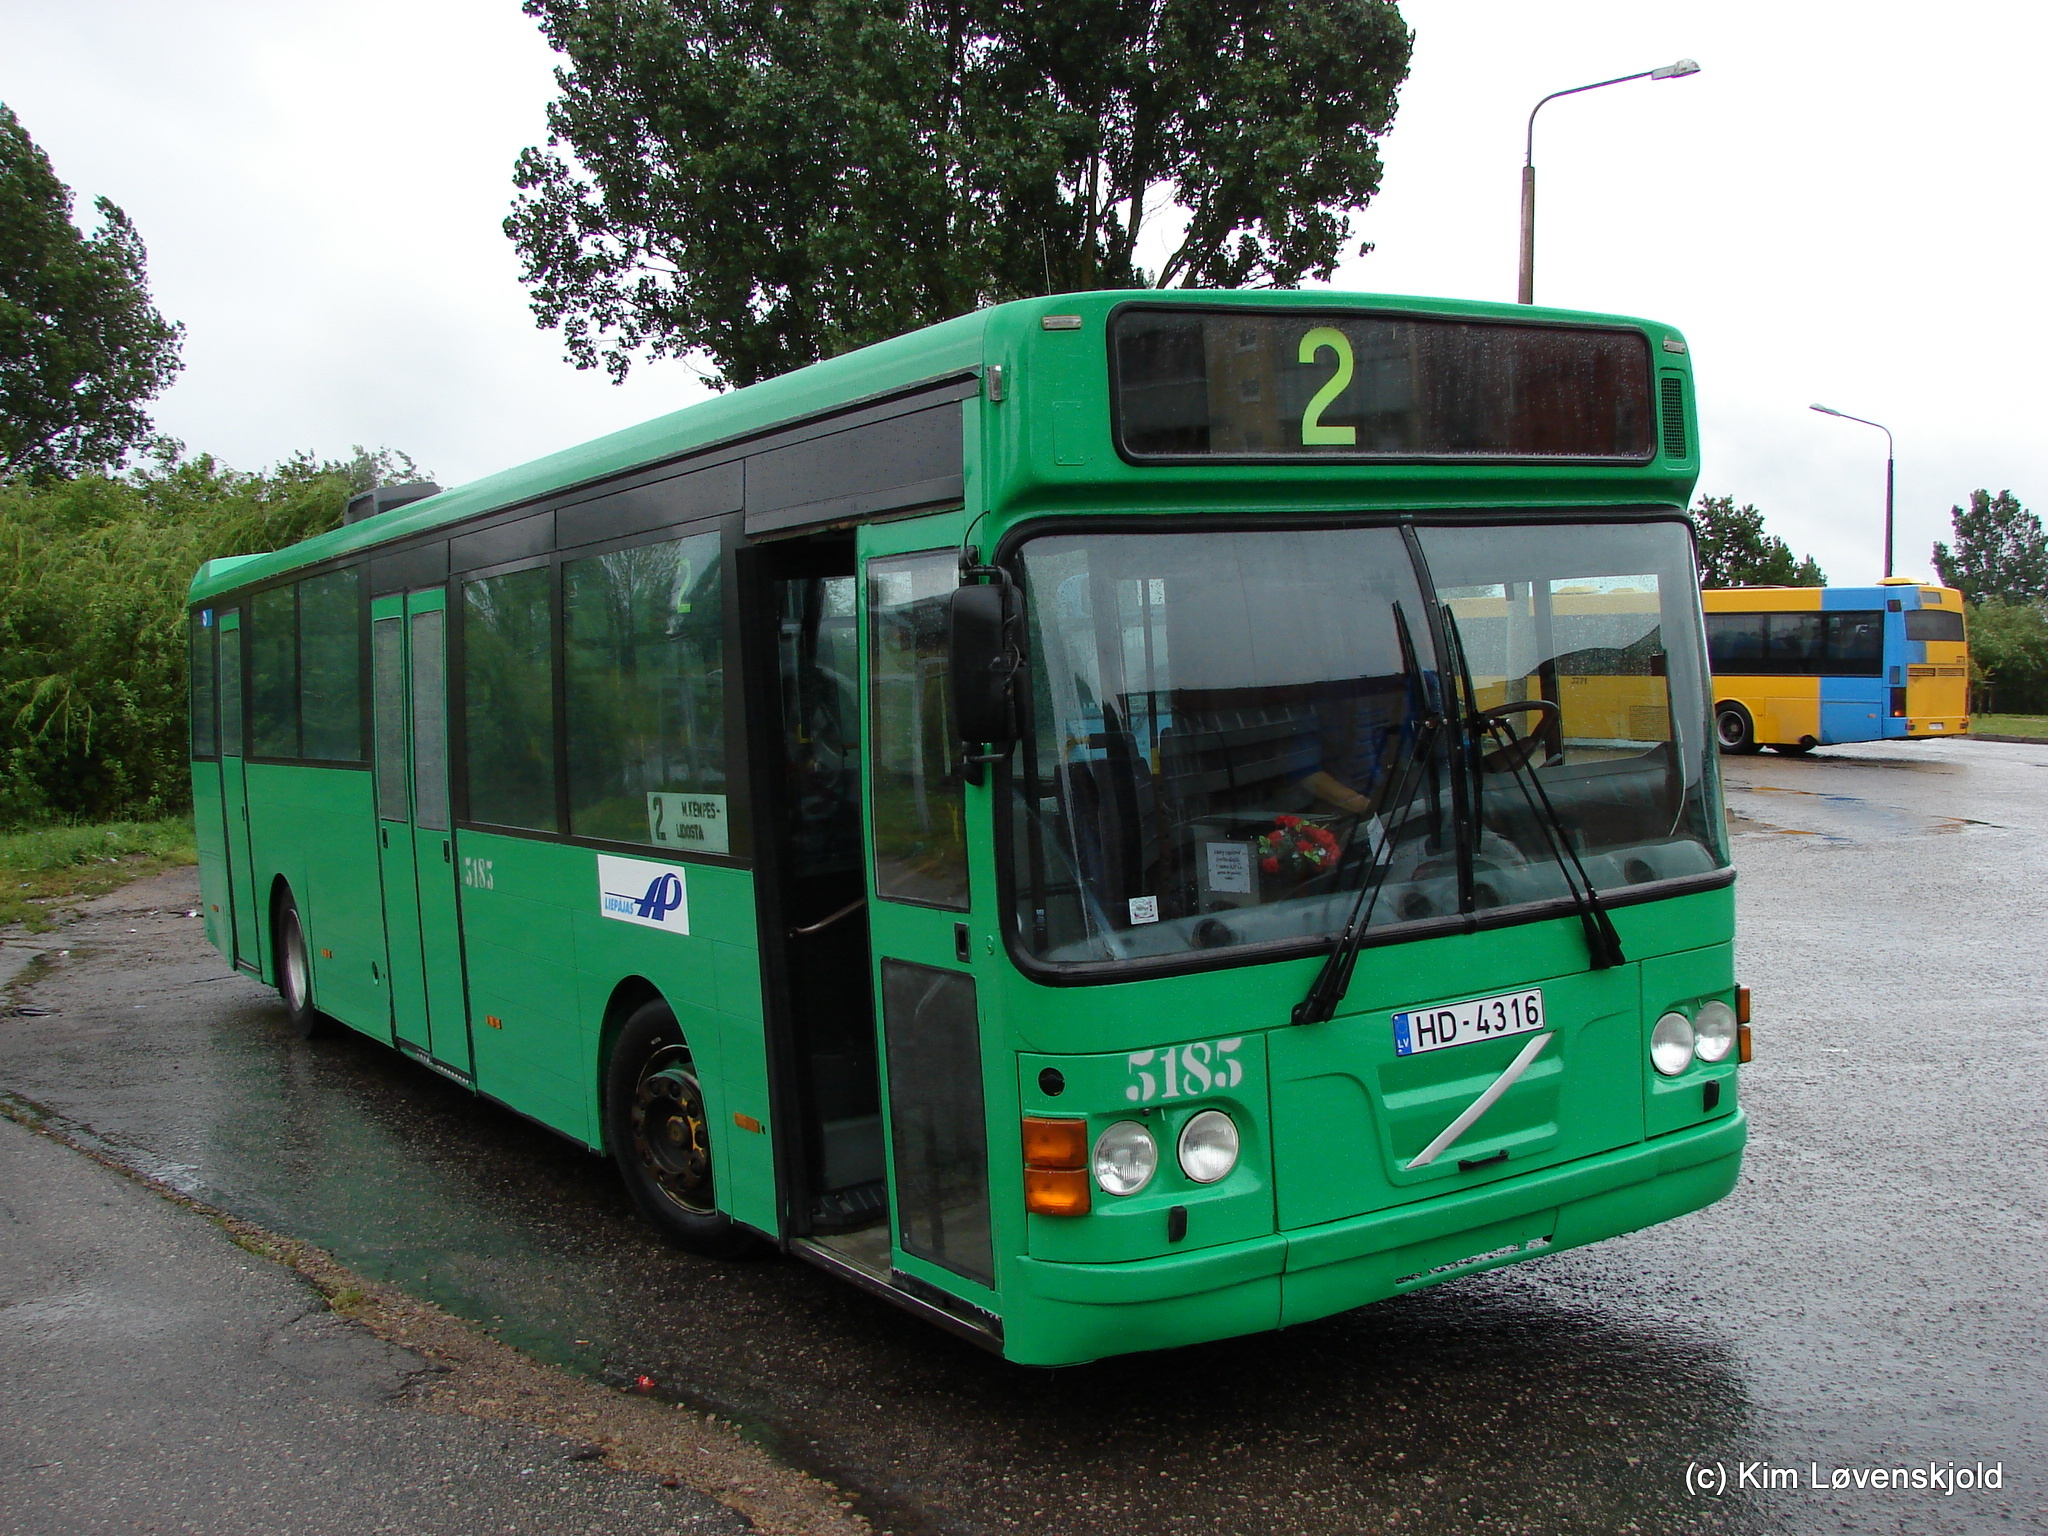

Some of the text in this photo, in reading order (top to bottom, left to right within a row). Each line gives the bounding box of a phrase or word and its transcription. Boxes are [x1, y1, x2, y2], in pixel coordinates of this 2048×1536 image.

[1298, 326, 1356, 446] 2
[676, 556, 692, 614] 2
[653, 796, 667, 841] 2
[676, 823, 705, 841] LIDOSTA
[464, 857, 494, 890] 5185
[1397, 1037, 1410, 1049] LV
[1415, 995, 1539, 1047] HD-4316
[1125, 1037, 1243, 1101] 5185
